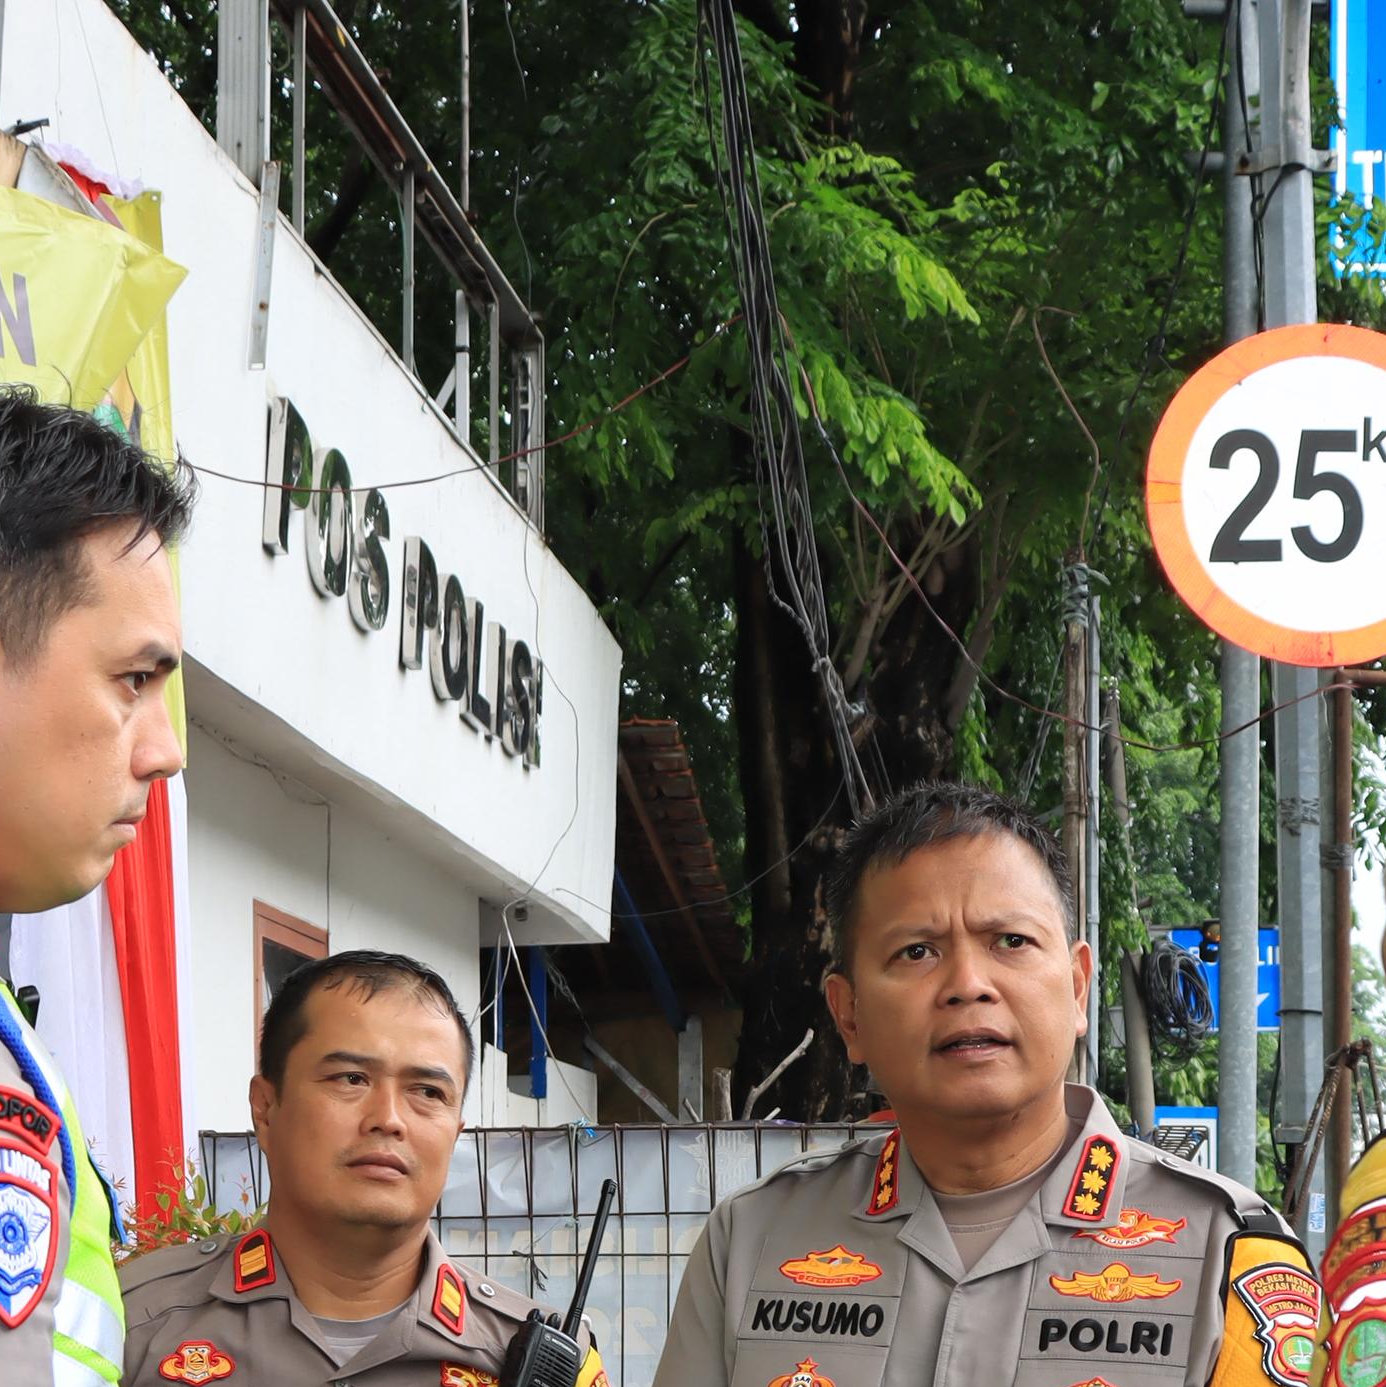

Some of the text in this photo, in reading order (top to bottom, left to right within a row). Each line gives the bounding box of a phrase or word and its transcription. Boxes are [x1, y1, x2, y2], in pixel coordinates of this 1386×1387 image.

[1208, 428, 1364, 563] 25
[262, 397, 544, 769] POS POLISI
[4, 1150, 51, 1192] LINTAS
[1250, 1273, 1285, 1292] POLRES
[1257, 1282, 1290, 1297] BEKASI
[752, 1299, 884, 1337] KUSUMO
[1039, 1318, 1173, 1356] POLRI
